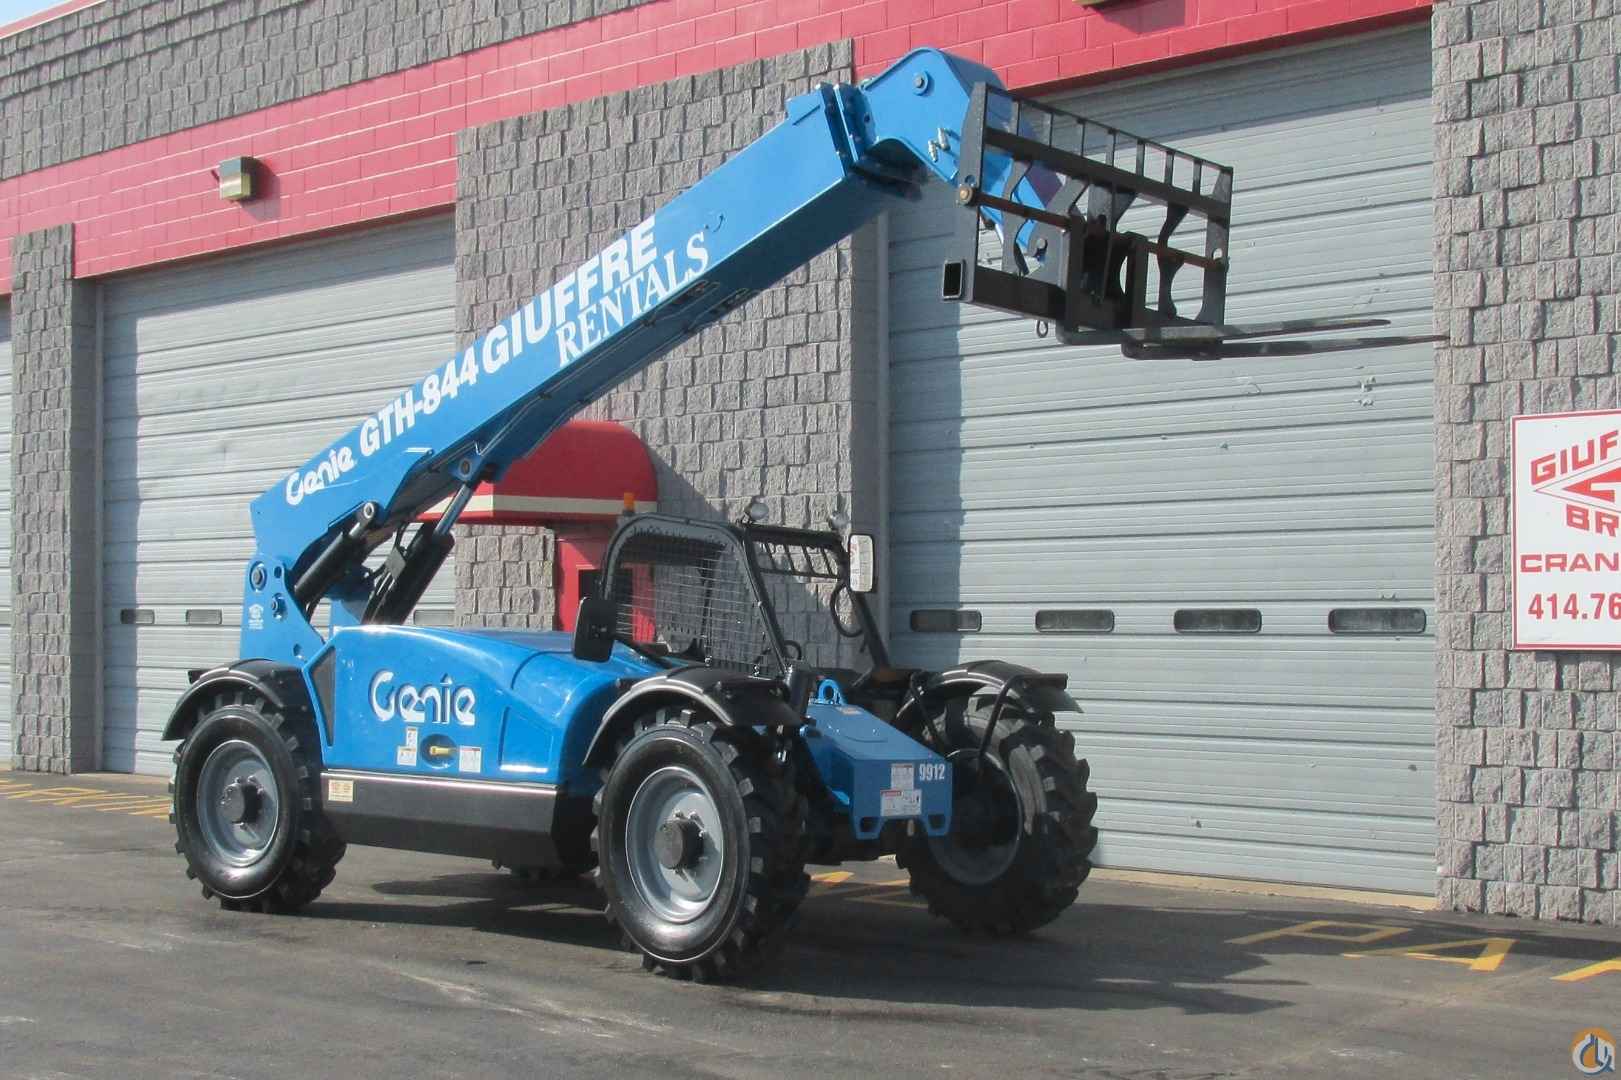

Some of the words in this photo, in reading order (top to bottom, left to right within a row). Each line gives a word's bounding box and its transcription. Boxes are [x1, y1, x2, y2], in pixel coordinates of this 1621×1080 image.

[482, 215, 658, 374] GIUFFRE
[556, 231, 709, 368] RENTALS
[285, 446, 356, 506] Genie
[360, 345, 480, 457] GTH-844
[1530, 429, 1619, 486] GIUF
[1566, 503, 1619, 538] BR
[1520, 552, 1619, 573] CRAN
[1528, 592, 1621, 620] 414.76
[369, 669, 476, 727] Genie
[919, 763, 945, 781] 9912
